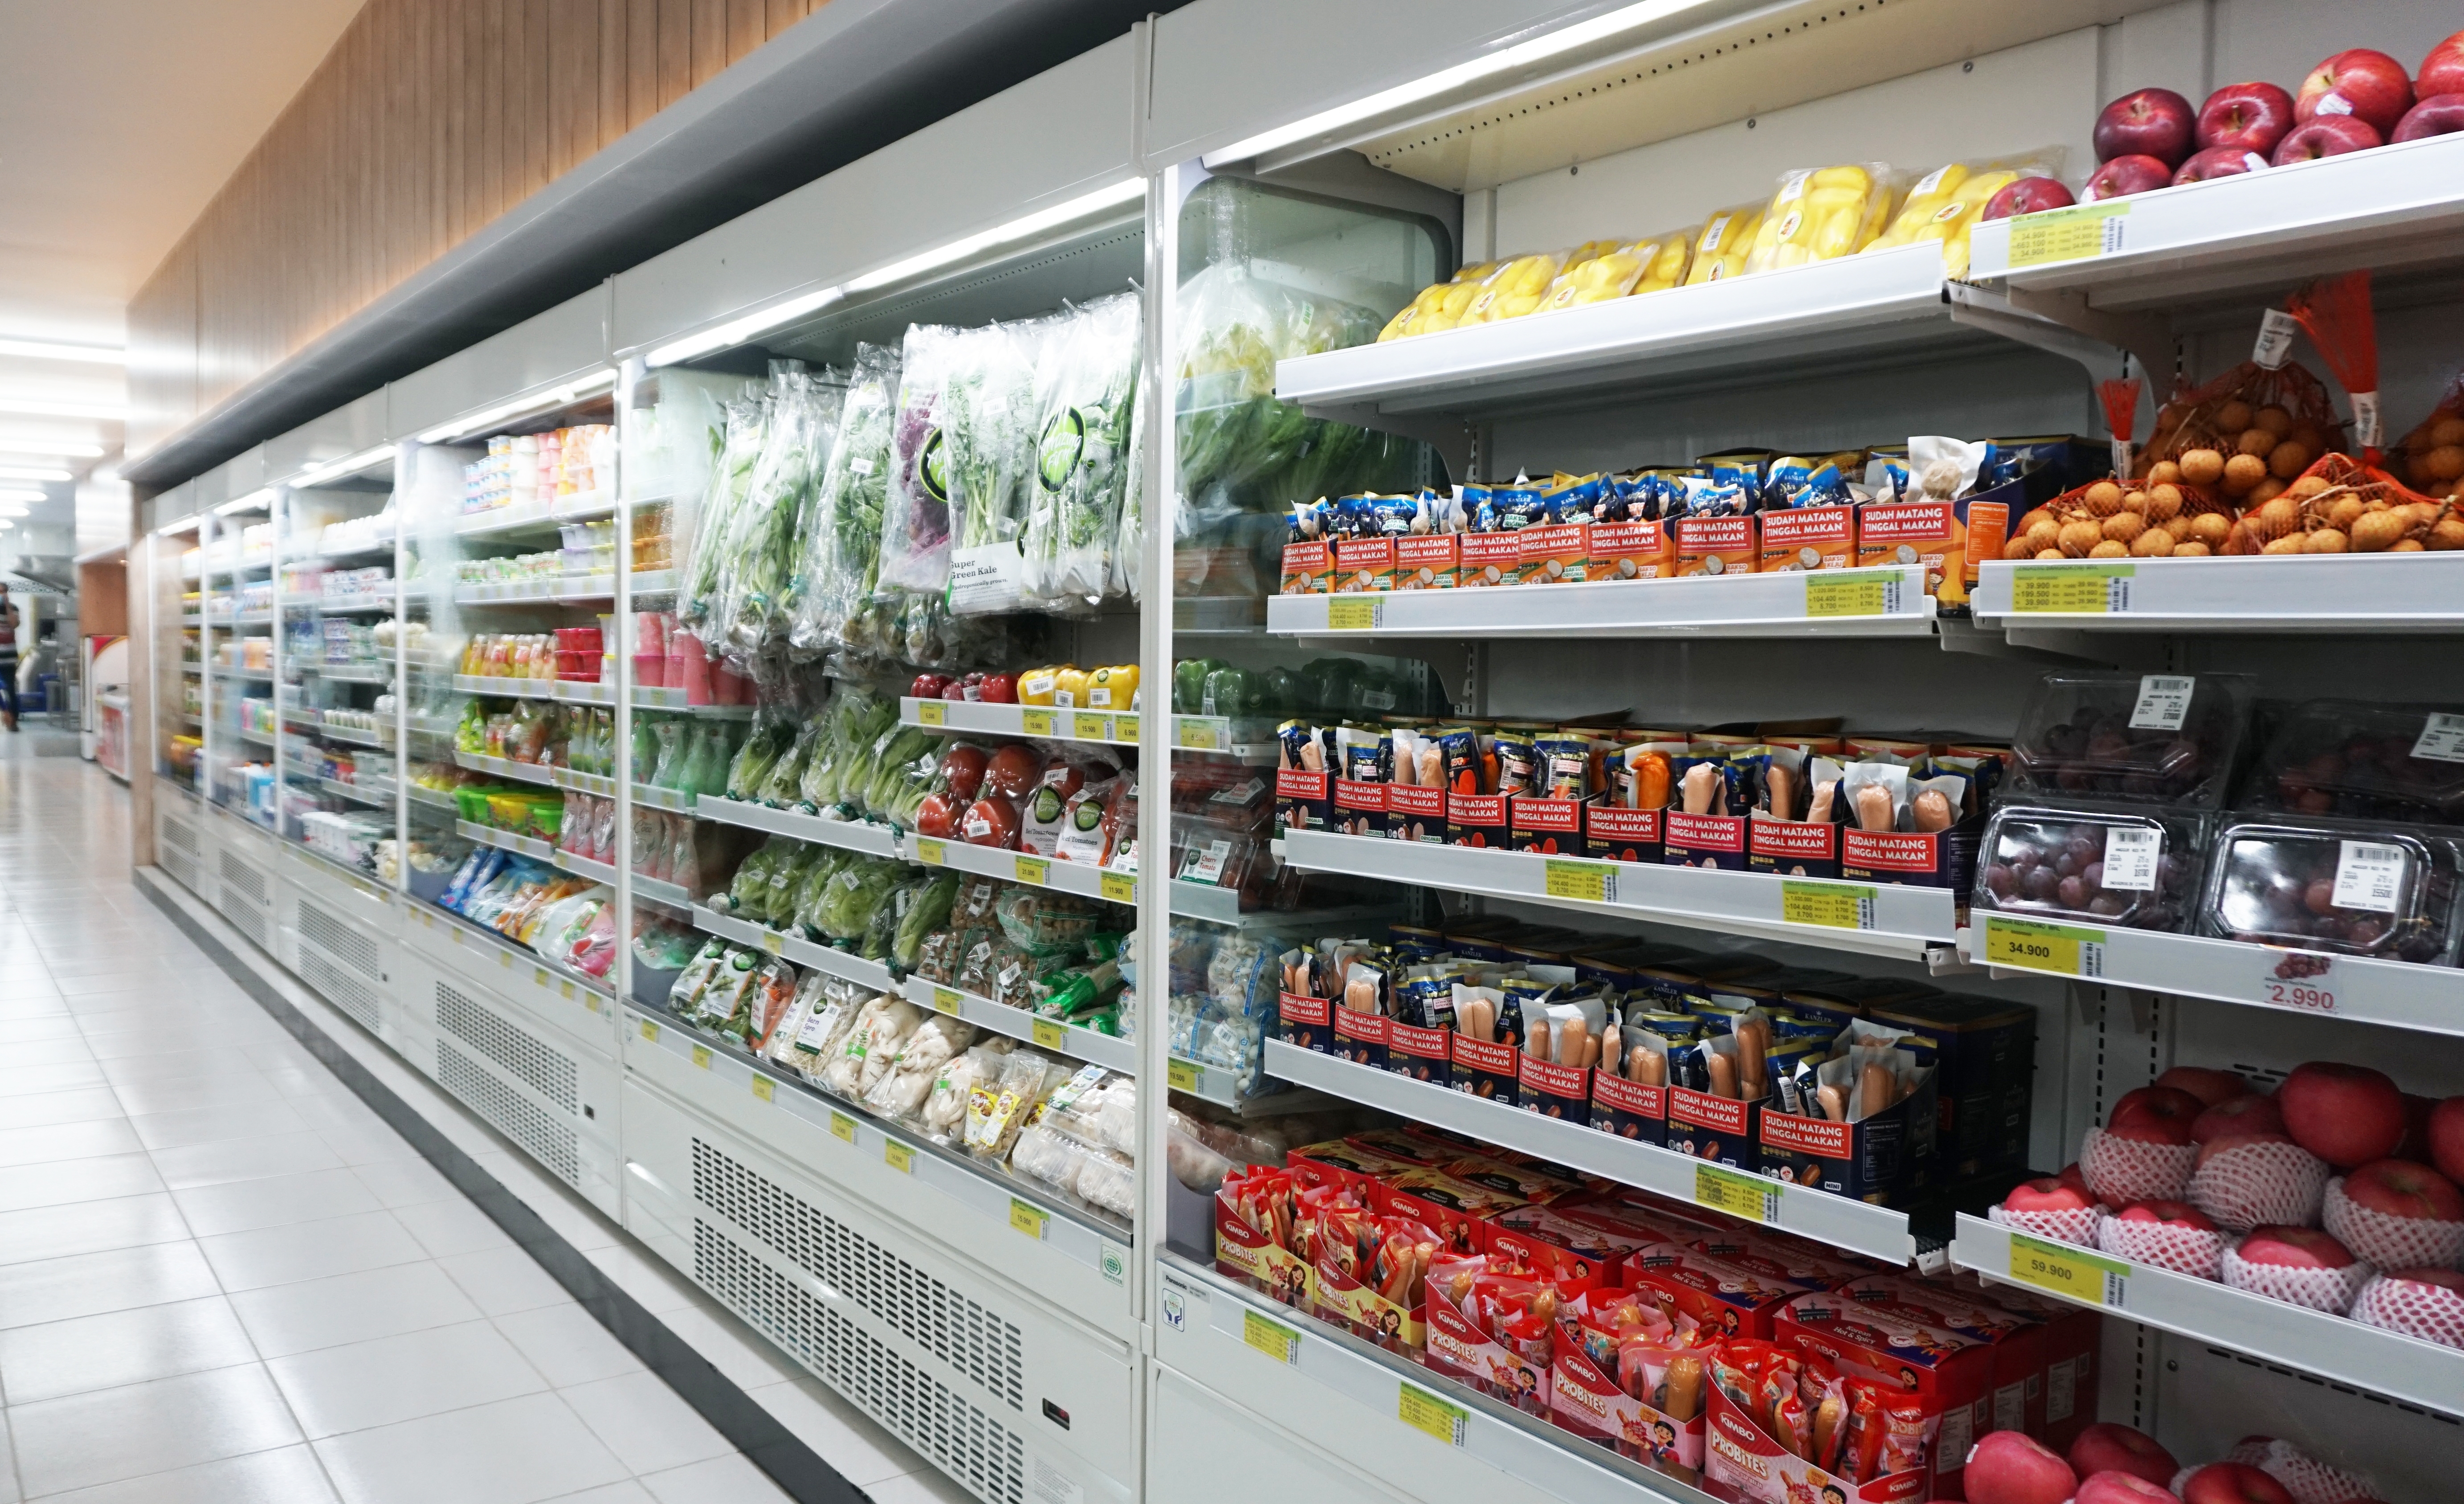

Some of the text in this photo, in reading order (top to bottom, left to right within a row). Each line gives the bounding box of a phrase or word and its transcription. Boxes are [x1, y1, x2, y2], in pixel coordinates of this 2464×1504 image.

[1560, 494, 1584, 505] KANZLER
[1766, 511, 1843, 527] SUDAH MATANG
[1865, 507, 1942, 521] SUDAH MATANG
[1682, 521, 1745, 532] SUDAH MATANG
[1766, 526, 1802, 537] TINGGAL
[1864, 522, 1900, 532] TINGGAL
[1521, 527, 1580, 542] SUDAH MATANG
[1681, 534, 1707, 543] TINGGAL
[1339, 542, 1387, 553] SUDAH MATANG
[1399, 539, 1450, 550] SUDAH MATANG
[1520, 540, 1548, 551] TINGGAL
[1338, 553, 1361, 561] TINGGAL
[1399, 550, 1421, 558] TINGGAL
[951, 565, 997, 580] Green Kale
[2025, 581, 2050, 590] 39.900
[1279, 773, 1320, 783] SUDAH MATANG
[1279, 781, 1298, 789] TINGGAL
[1338, 783, 1382, 795] SUDAH MATANG
[1337, 791, 1357, 801] TINGGAL
[1390, 786, 1438, 799] SUDAH MATANG
[1391, 795, 1411, 805] TINGGAL
[1590, 811, 1652, 822] SUDAH MATANG
[1590, 821, 1619, 831] TINGGAL
[1670, 816, 1735, 831] SUDAH MATANG
[1033, 829, 1058, 837] Tomatoes
[1669, 826, 1699, 838] TINGGAL
[1754, 824, 1825, 838] SUDAH MATANG
[1071, 837, 1097, 845] Tomatoes
[1753, 834, 1786, 846] TINGGAL
[1848, 835, 1926, 850] SUDAH MATANG
[1848, 846, 1883, 858] TINGGAL
[1201, 855, 1216, 863] Cherry
[1199, 862, 1216, 871] Tomato
[1109, 887, 1123, 895] 11.900
[2009, 941, 2050, 958] 34.900
[1653, 985, 1677, 995] KANZLER
[1040, 1032, 1051, 1041] 4.500
[1392, 1026, 1442, 1042] SUDAH MATANG
[1392, 1034, 1416, 1046] TINGGAL
[1455, 1038, 1510, 1058] SUDAH MATANG
[1455, 1047, 1481, 1061] TINGGAL
[1170, 1072, 1185, 1082] 19.500
[1673, 1100, 1705, 1117] TINGGAL
[1674, 1091, 1739, 1114] SUDAH MATANG
[1766, 1116, 1842, 1137] SUDAH MATANG
[1765, 1125, 1802, 1141] TINGGAL
[1392, 1201, 1420, 1217] KIMBO
[1017, 1214, 1031, 1226] 15.900
[1226, 1224, 1249, 1239] KIMBO
[1320, 1261, 1339, 1280] KIMBO
[2031, 1259, 2072, 1282] 59.900
[1103, 1272, 1122, 1285] INVERTER
[1166, 1275, 1187, 1290] Panasonic
[1673, 1272, 1682, 1280] Hot
[1689, 1278, 1708, 1290] Spicy
[1683, 1271, 1705, 1283] Korean
[1439, 1313, 1466, 1332] KIMBO
[1834, 1327, 1847, 1336] Hot
[1855, 1334, 1876, 1345] Spicy
[1845, 1324, 1871, 1337] Korean
[1567, 1356, 1596, 1381] KIMBO
[1404, 1396, 1421, 1409] 554.400
[1406, 1404, 1421, 1414] 92.400
[1408, 1412, 1420, 1421] 7.700
[1721, 1414, 1754, 1441] KIMBO
[1889, 1479, 1917, 1492] KIMBO
